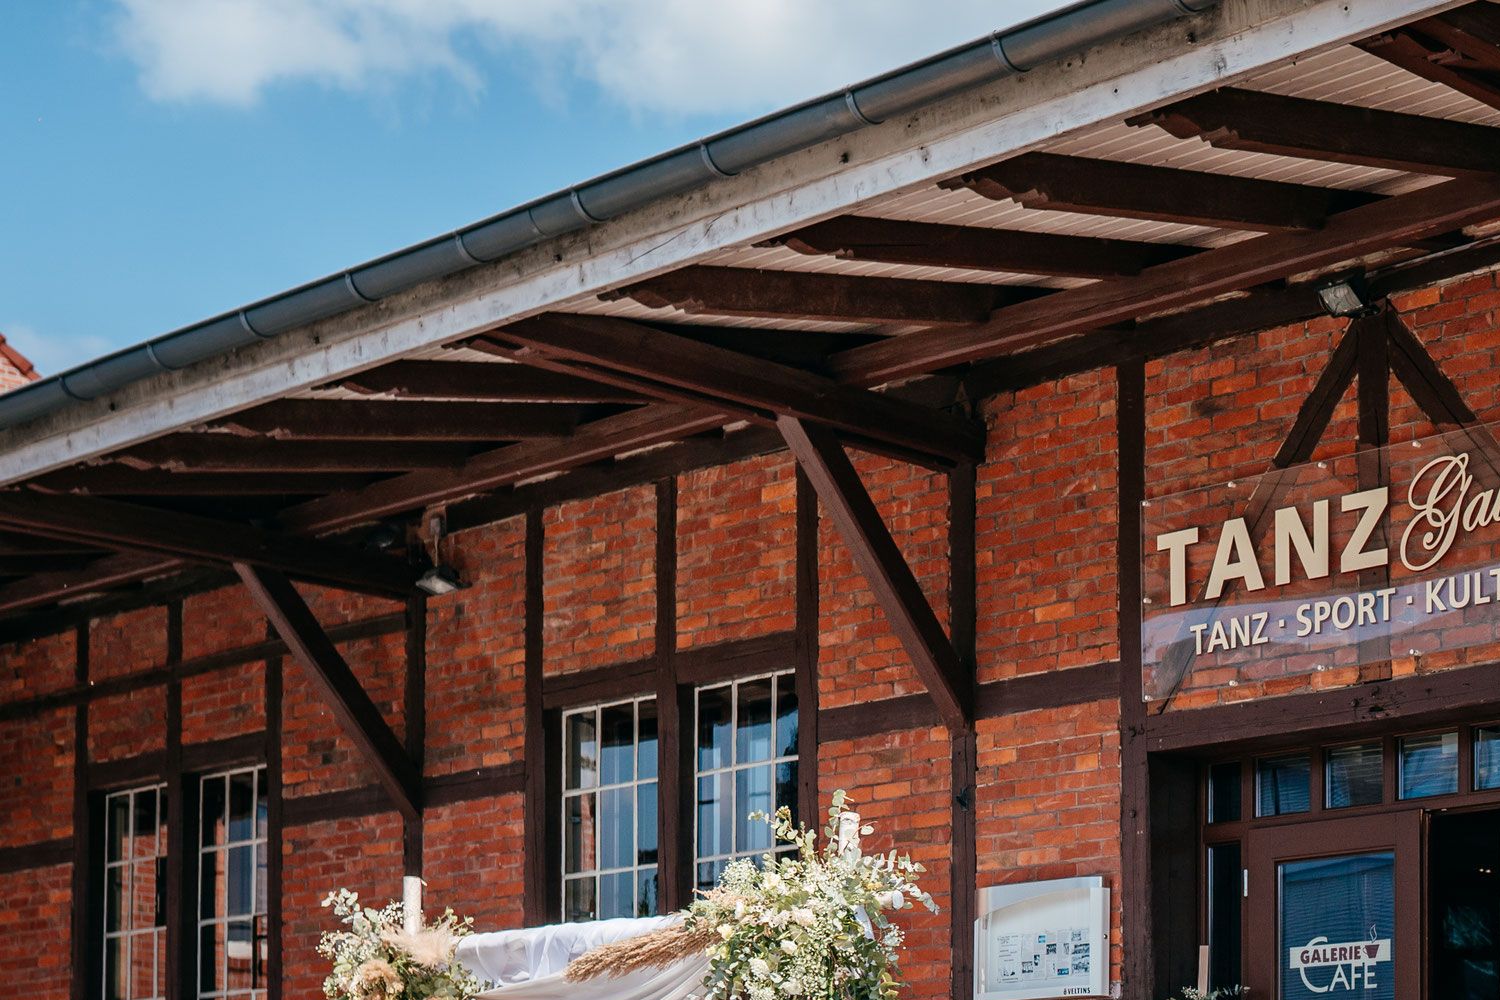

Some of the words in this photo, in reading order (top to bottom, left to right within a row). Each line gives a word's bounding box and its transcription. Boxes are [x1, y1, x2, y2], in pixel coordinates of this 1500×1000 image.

[1156, 486, 1389, 607] TANZ
[1190, 611, 1268, 656] TANZ
[1296, 586, 1397, 638] SPORT
[1300, 945, 1361, 964] GALERIE
[1067, 987, 1091, 995] VELTINS
